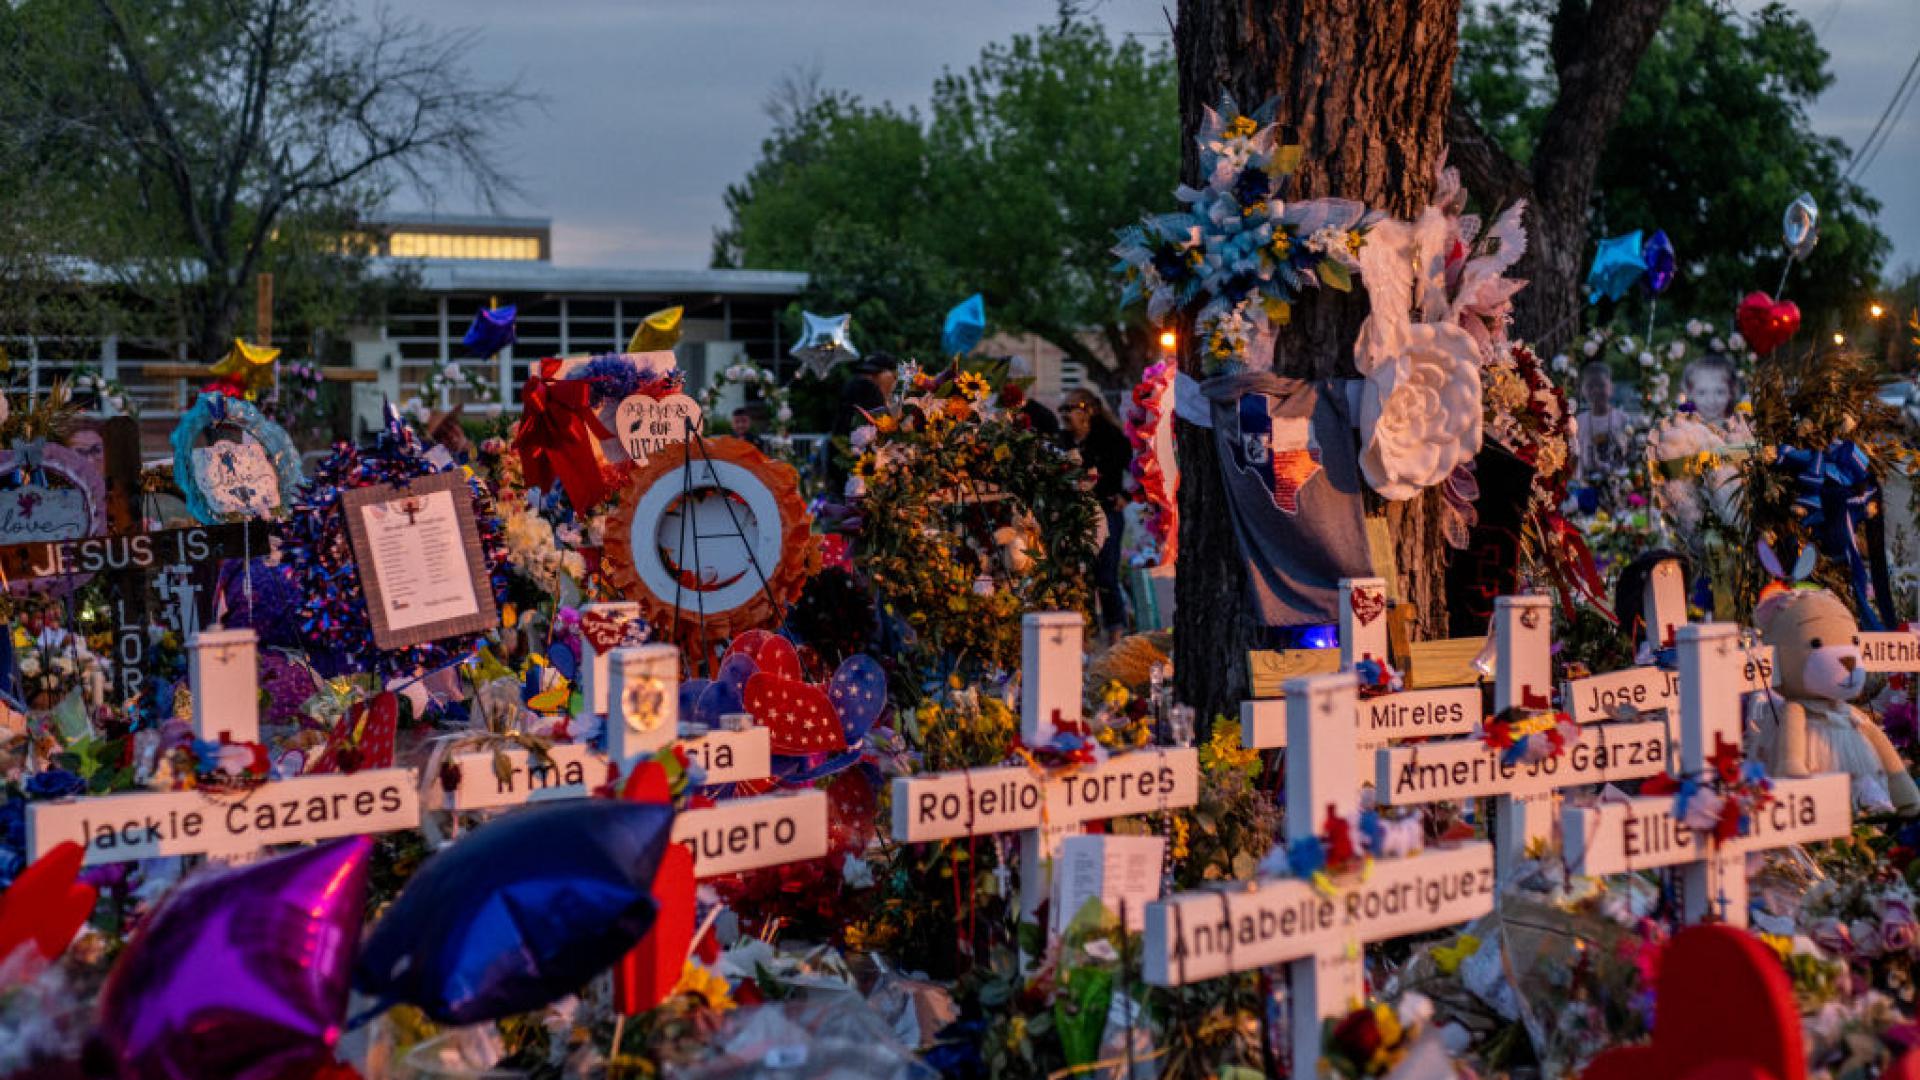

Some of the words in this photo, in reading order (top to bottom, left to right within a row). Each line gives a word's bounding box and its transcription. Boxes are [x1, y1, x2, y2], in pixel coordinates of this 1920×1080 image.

[32, 536, 153, 577] JESUS
[177, 530, 209, 561] IS
[118, 600, 145, 699] LOR
[1371, 702, 1463, 730] Mireles
[1589, 683, 1647, 713] Jose
[1397, 752, 1515, 794] Amerie
[1571, 738, 1662, 772] Garza
[82, 811, 203, 849] Jackie
[225, 785, 402, 834] Cazares
[919, 782, 1038, 828] Rojelio
[1062, 767, 1176, 805] Torres
[1623, 811, 1691, 857] Ellie
[1171, 899, 1335, 961] Annabelle
[1345, 868, 1493, 924] Rodriguez
